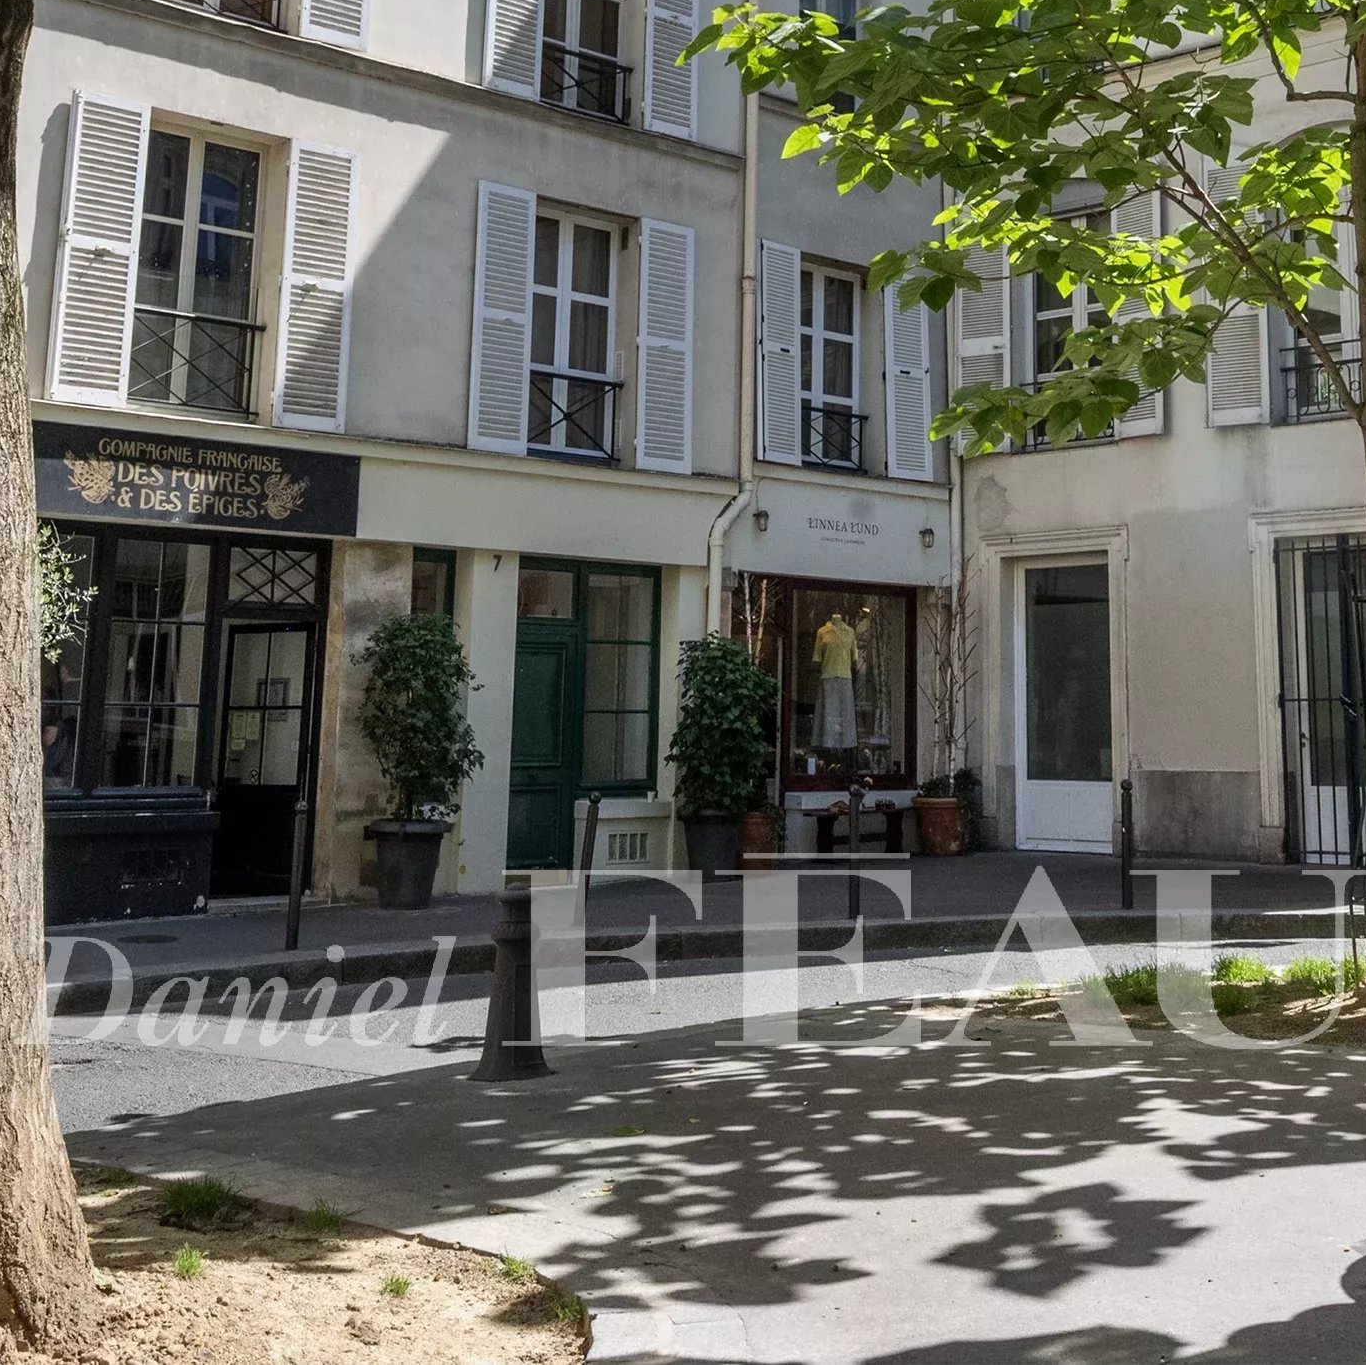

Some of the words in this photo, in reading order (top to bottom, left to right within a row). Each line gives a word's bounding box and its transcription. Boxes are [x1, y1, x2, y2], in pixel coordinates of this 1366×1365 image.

[98, 437, 193, 464] COMPAGNIE
[198, 450, 283, 473] FRANÇAISE
[117, 463, 164, 486] DES
[171, 467, 262, 496] POIVRES
[116, 488, 132, 508] &
[139, 490, 183, 513] DES
[188, 489, 259, 518] ÉPICES
[493, 554, 502, 572] 7
